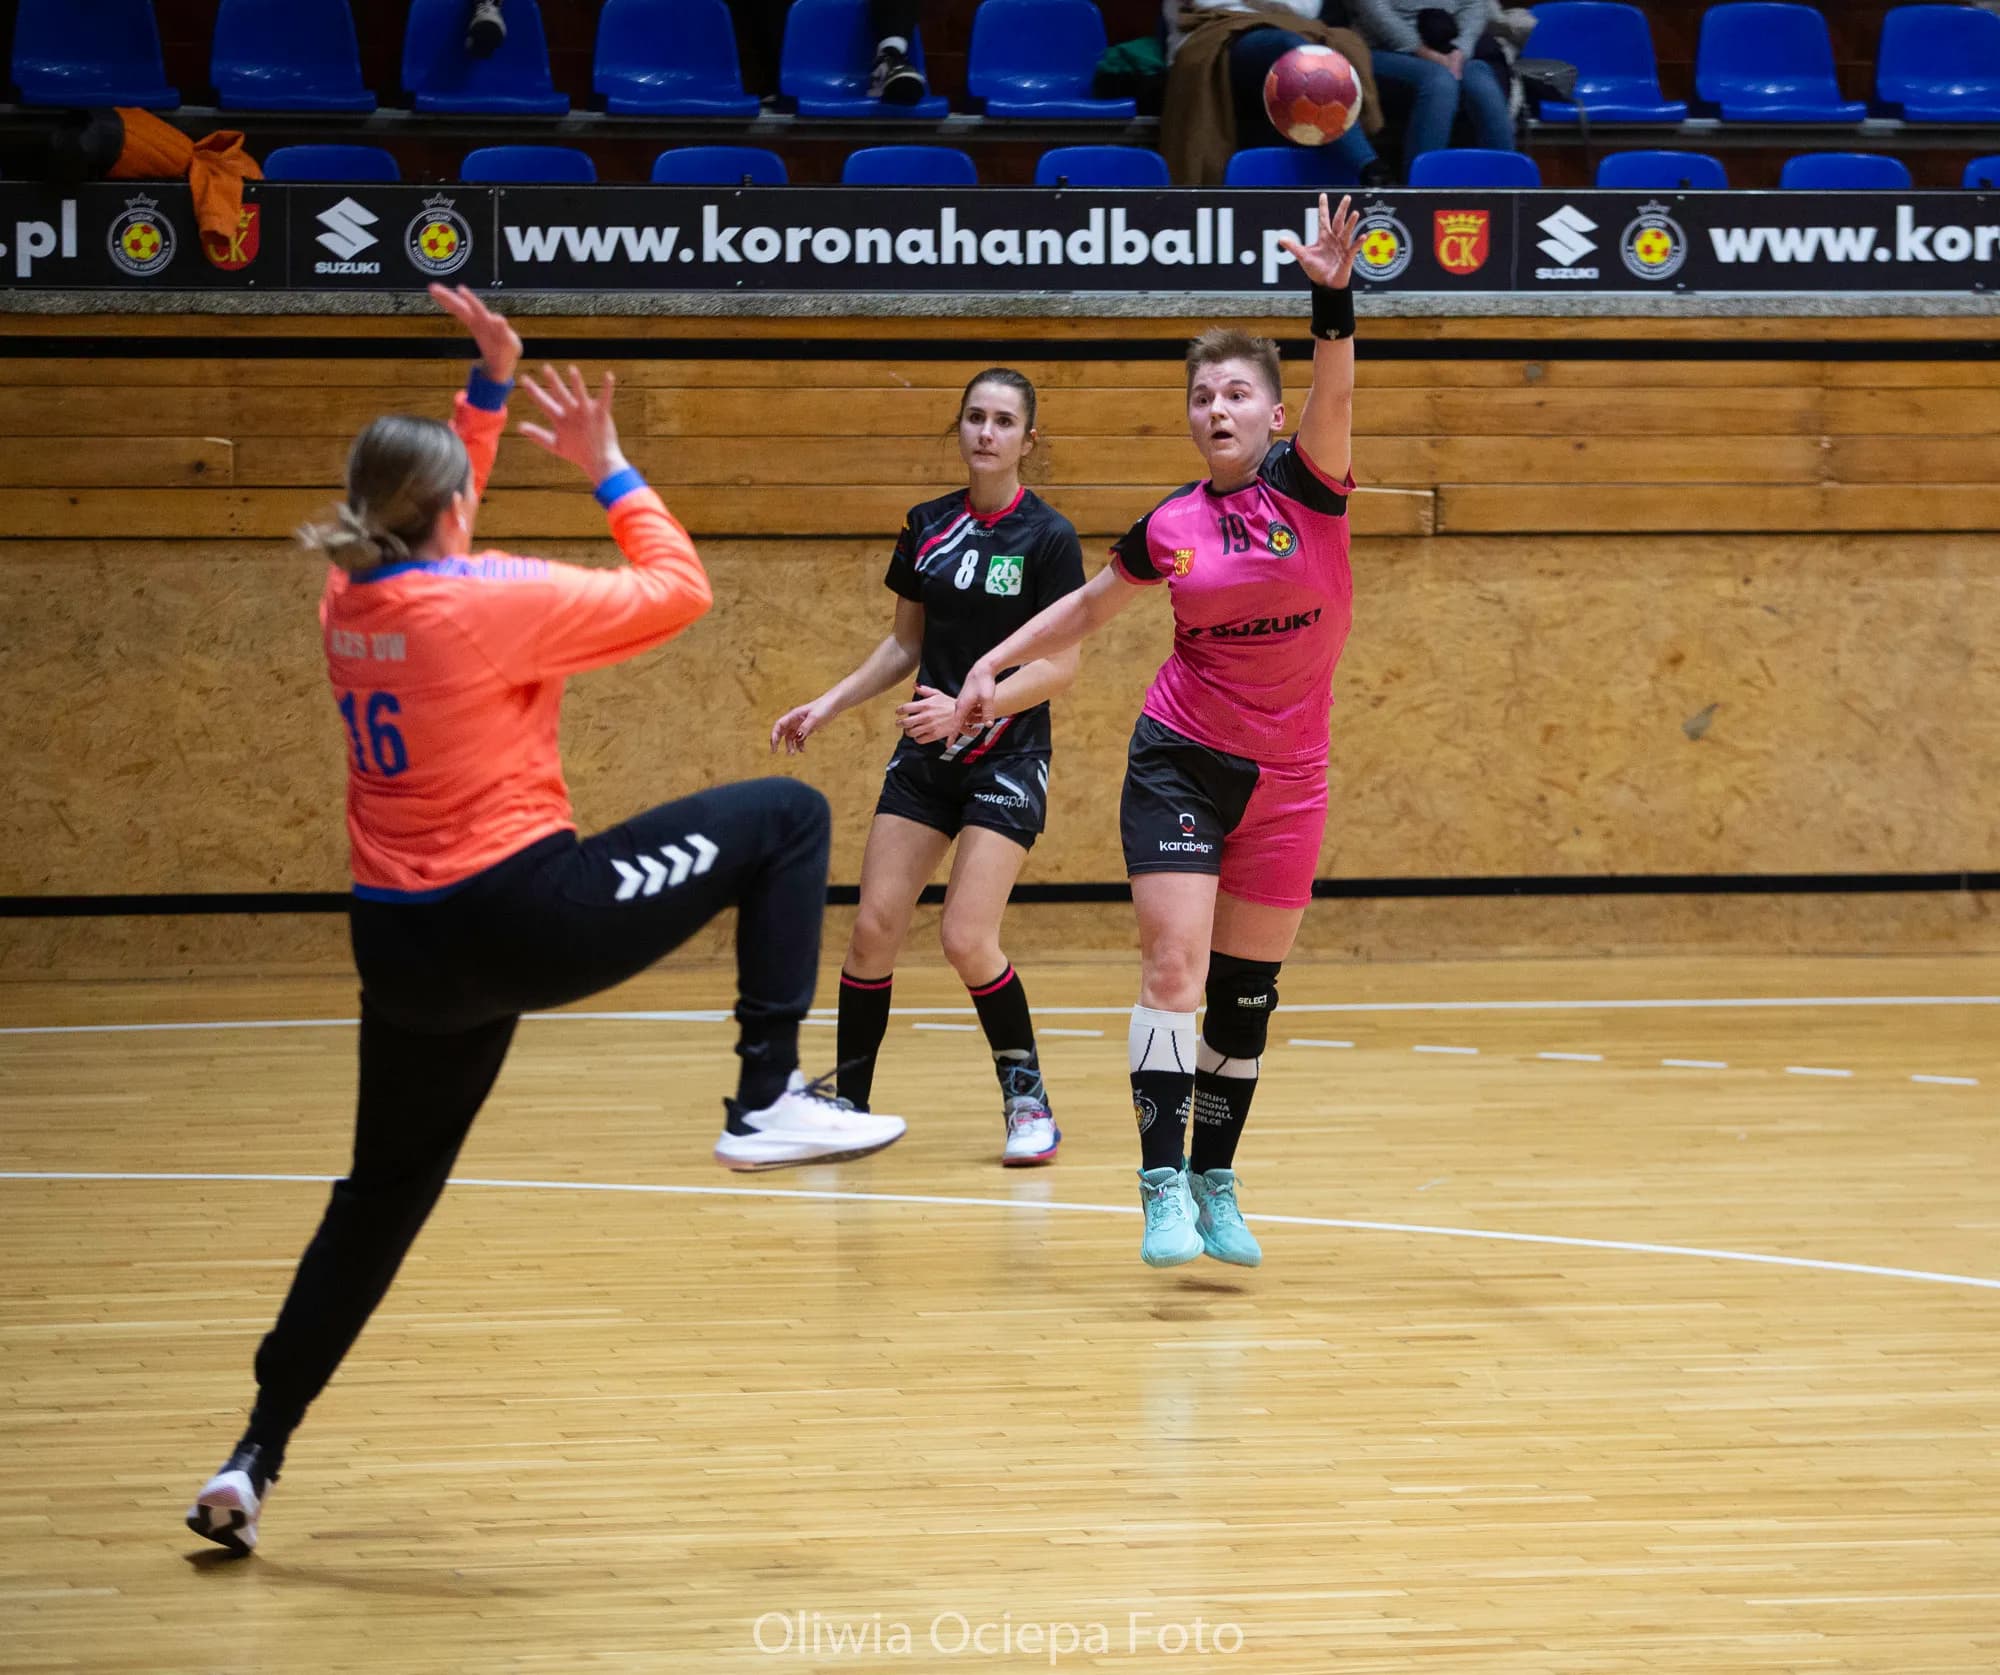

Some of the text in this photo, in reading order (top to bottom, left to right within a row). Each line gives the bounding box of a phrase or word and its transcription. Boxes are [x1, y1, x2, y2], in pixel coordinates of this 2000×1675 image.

[503, 204, 1320, 284] www.koronahandball.pl
[1439, 235, 1479, 267] CK
[314, 262, 381, 274] SUZUKI
[1535, 267, 1600, 280] SUZUKI
[1218, 513, 1250, 555] 19
[954, 549, 979, 590] 8
[339, 690, 410, 778] 16
[1237, 994, 1267, 1005] SELECT
